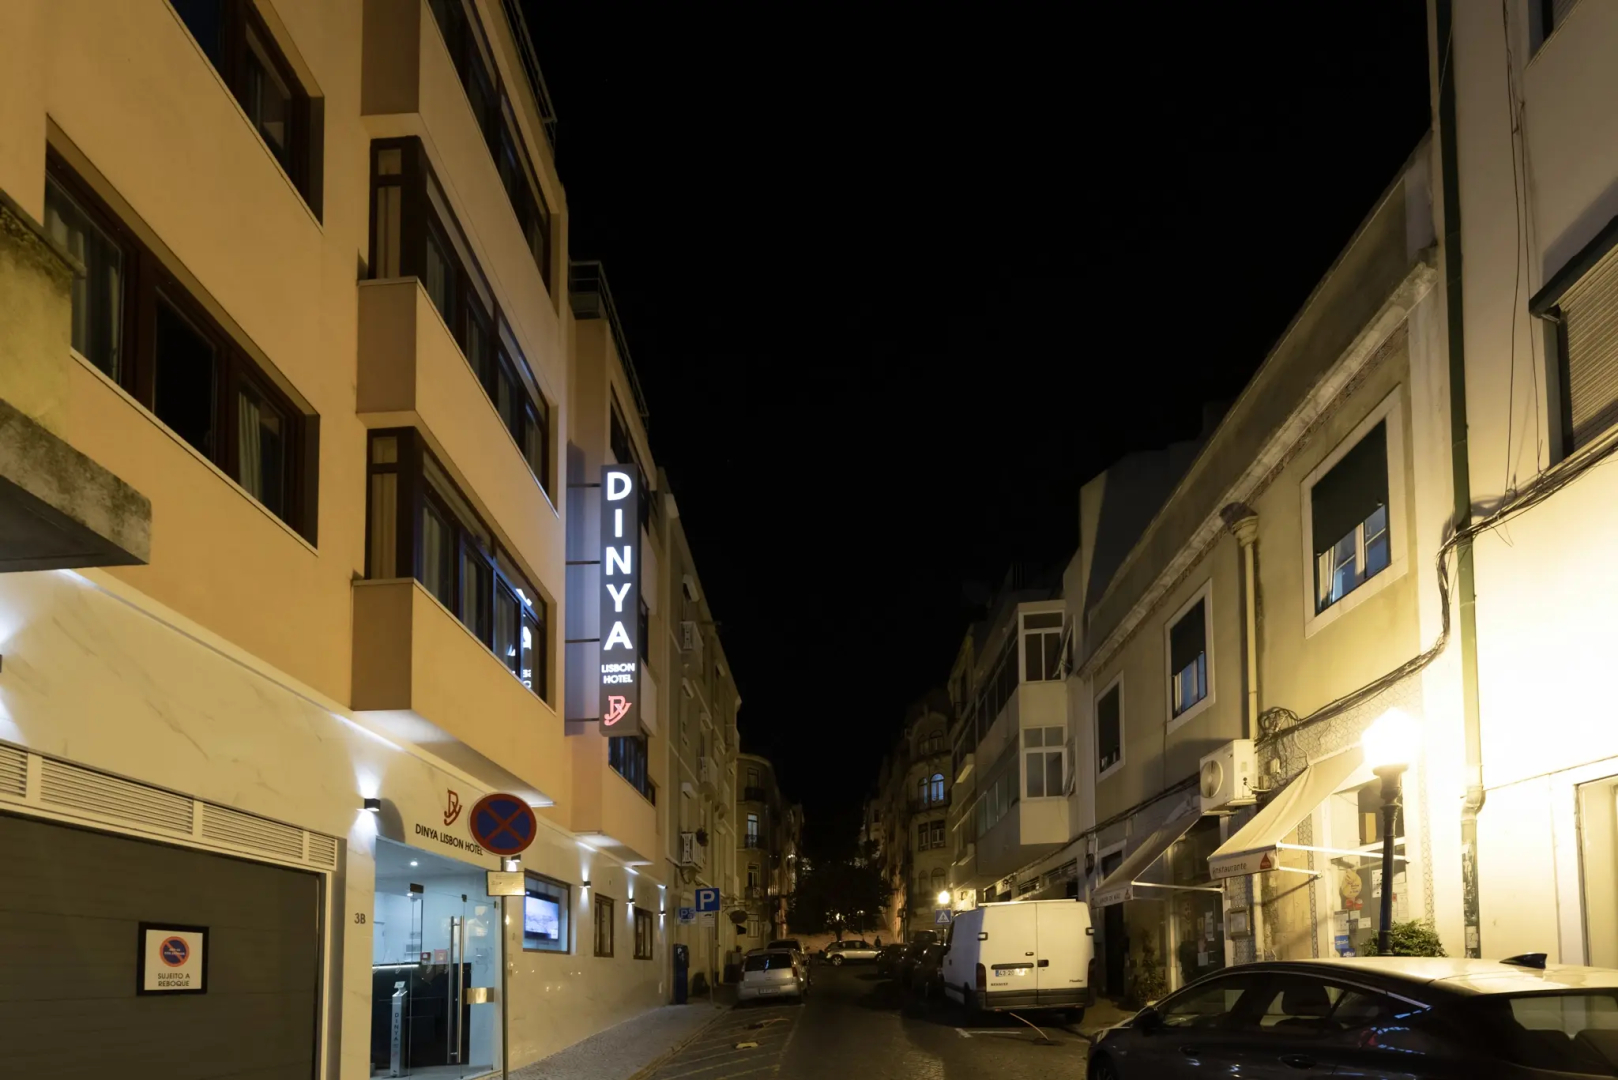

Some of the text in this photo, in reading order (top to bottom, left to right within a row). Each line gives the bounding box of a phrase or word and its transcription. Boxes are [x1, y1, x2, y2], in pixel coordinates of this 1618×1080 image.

[603, 471, 633, 650] DINYA
[601, 663, 635, 673] LISBON
[603, 674, 633, 684] HOTEL
[415, 823, 483, 856] DINYA LISBON HOTEL
[700, 890, 715, 910] P
[354, 912, 366, 924] 3B
